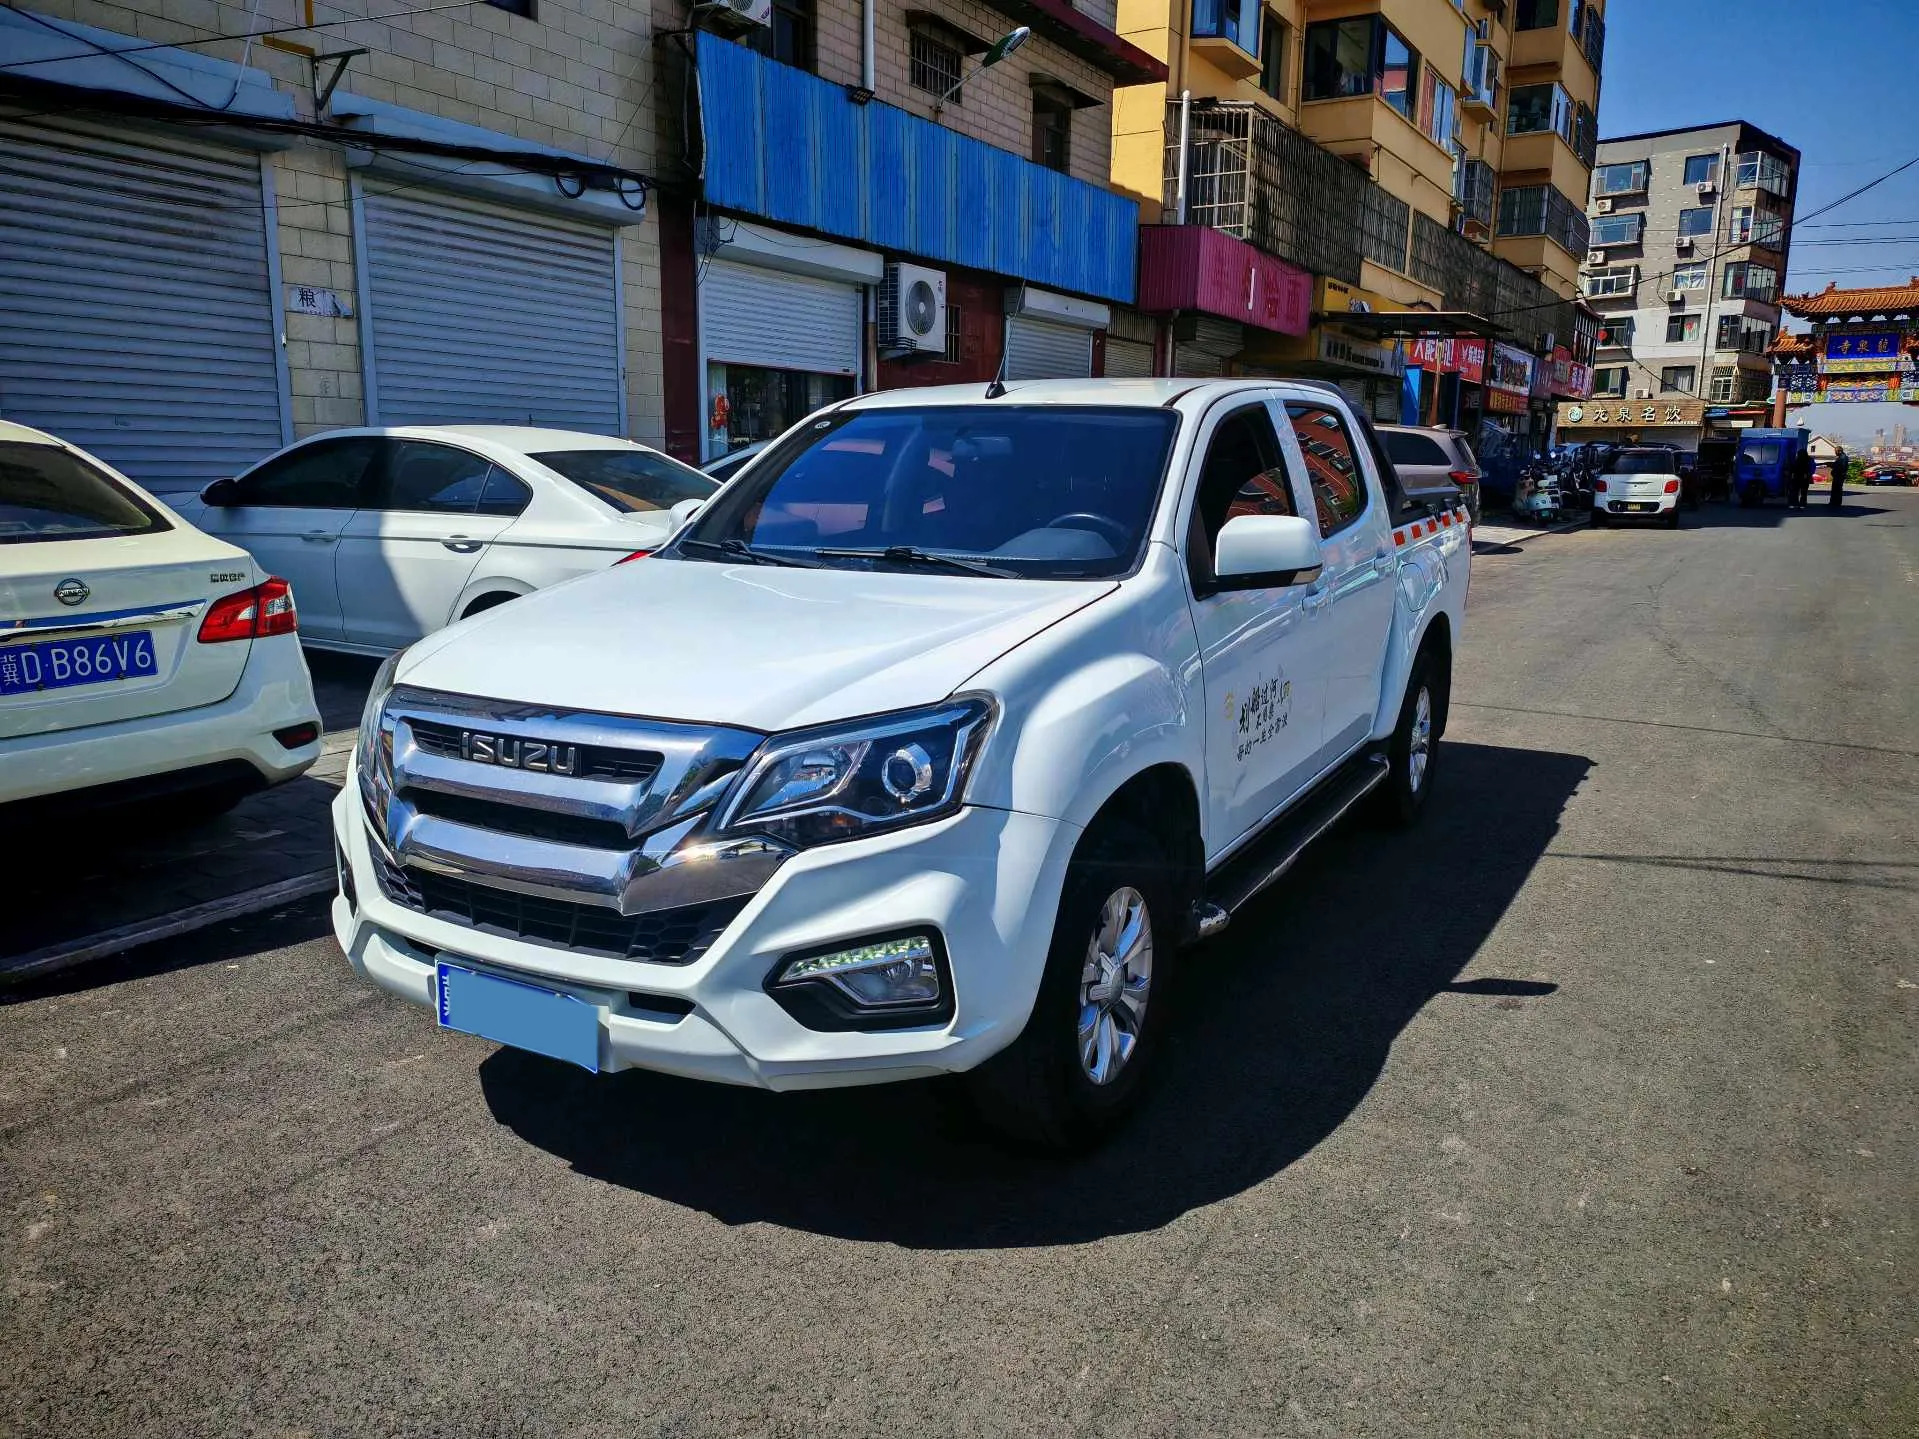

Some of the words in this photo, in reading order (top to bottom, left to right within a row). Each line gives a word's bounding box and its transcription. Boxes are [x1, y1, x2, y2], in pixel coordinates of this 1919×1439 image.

[1592, 405, 1683, 422] 龙泉名饮
[461, 730, 576, 775] ISUZU
